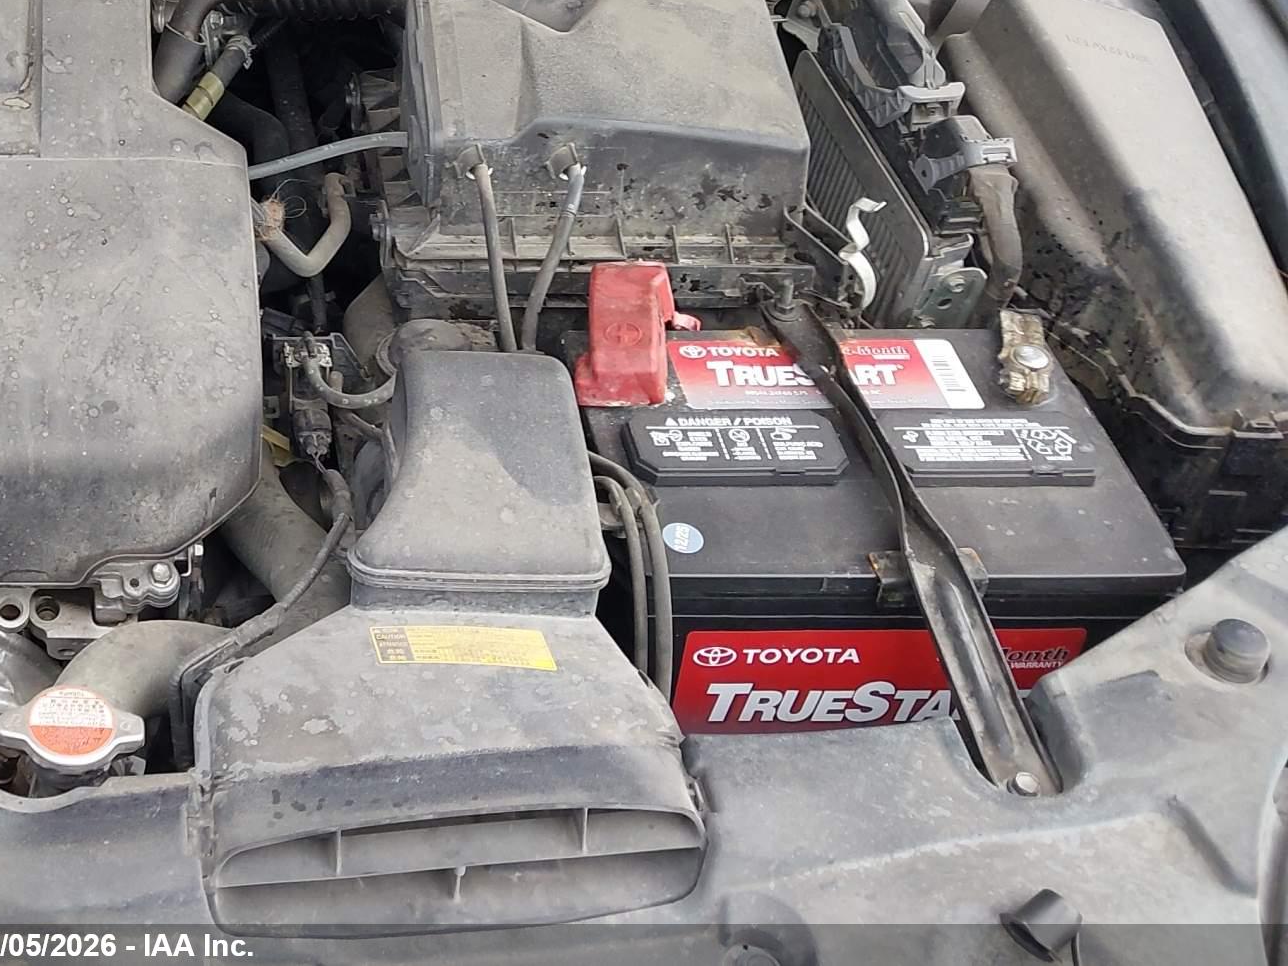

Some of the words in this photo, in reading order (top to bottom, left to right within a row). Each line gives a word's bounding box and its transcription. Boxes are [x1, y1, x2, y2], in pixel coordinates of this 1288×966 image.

[708, 345, 780, 358] TOYOTA
[678, 417, 732, 426] DANGER
[744, 417, 793, 426] POISON
[742, 647, 861, 664] TOYOTA
[1002, 646, 1069, 661] onth
[706, 680, 961, 723] TRUESTA
